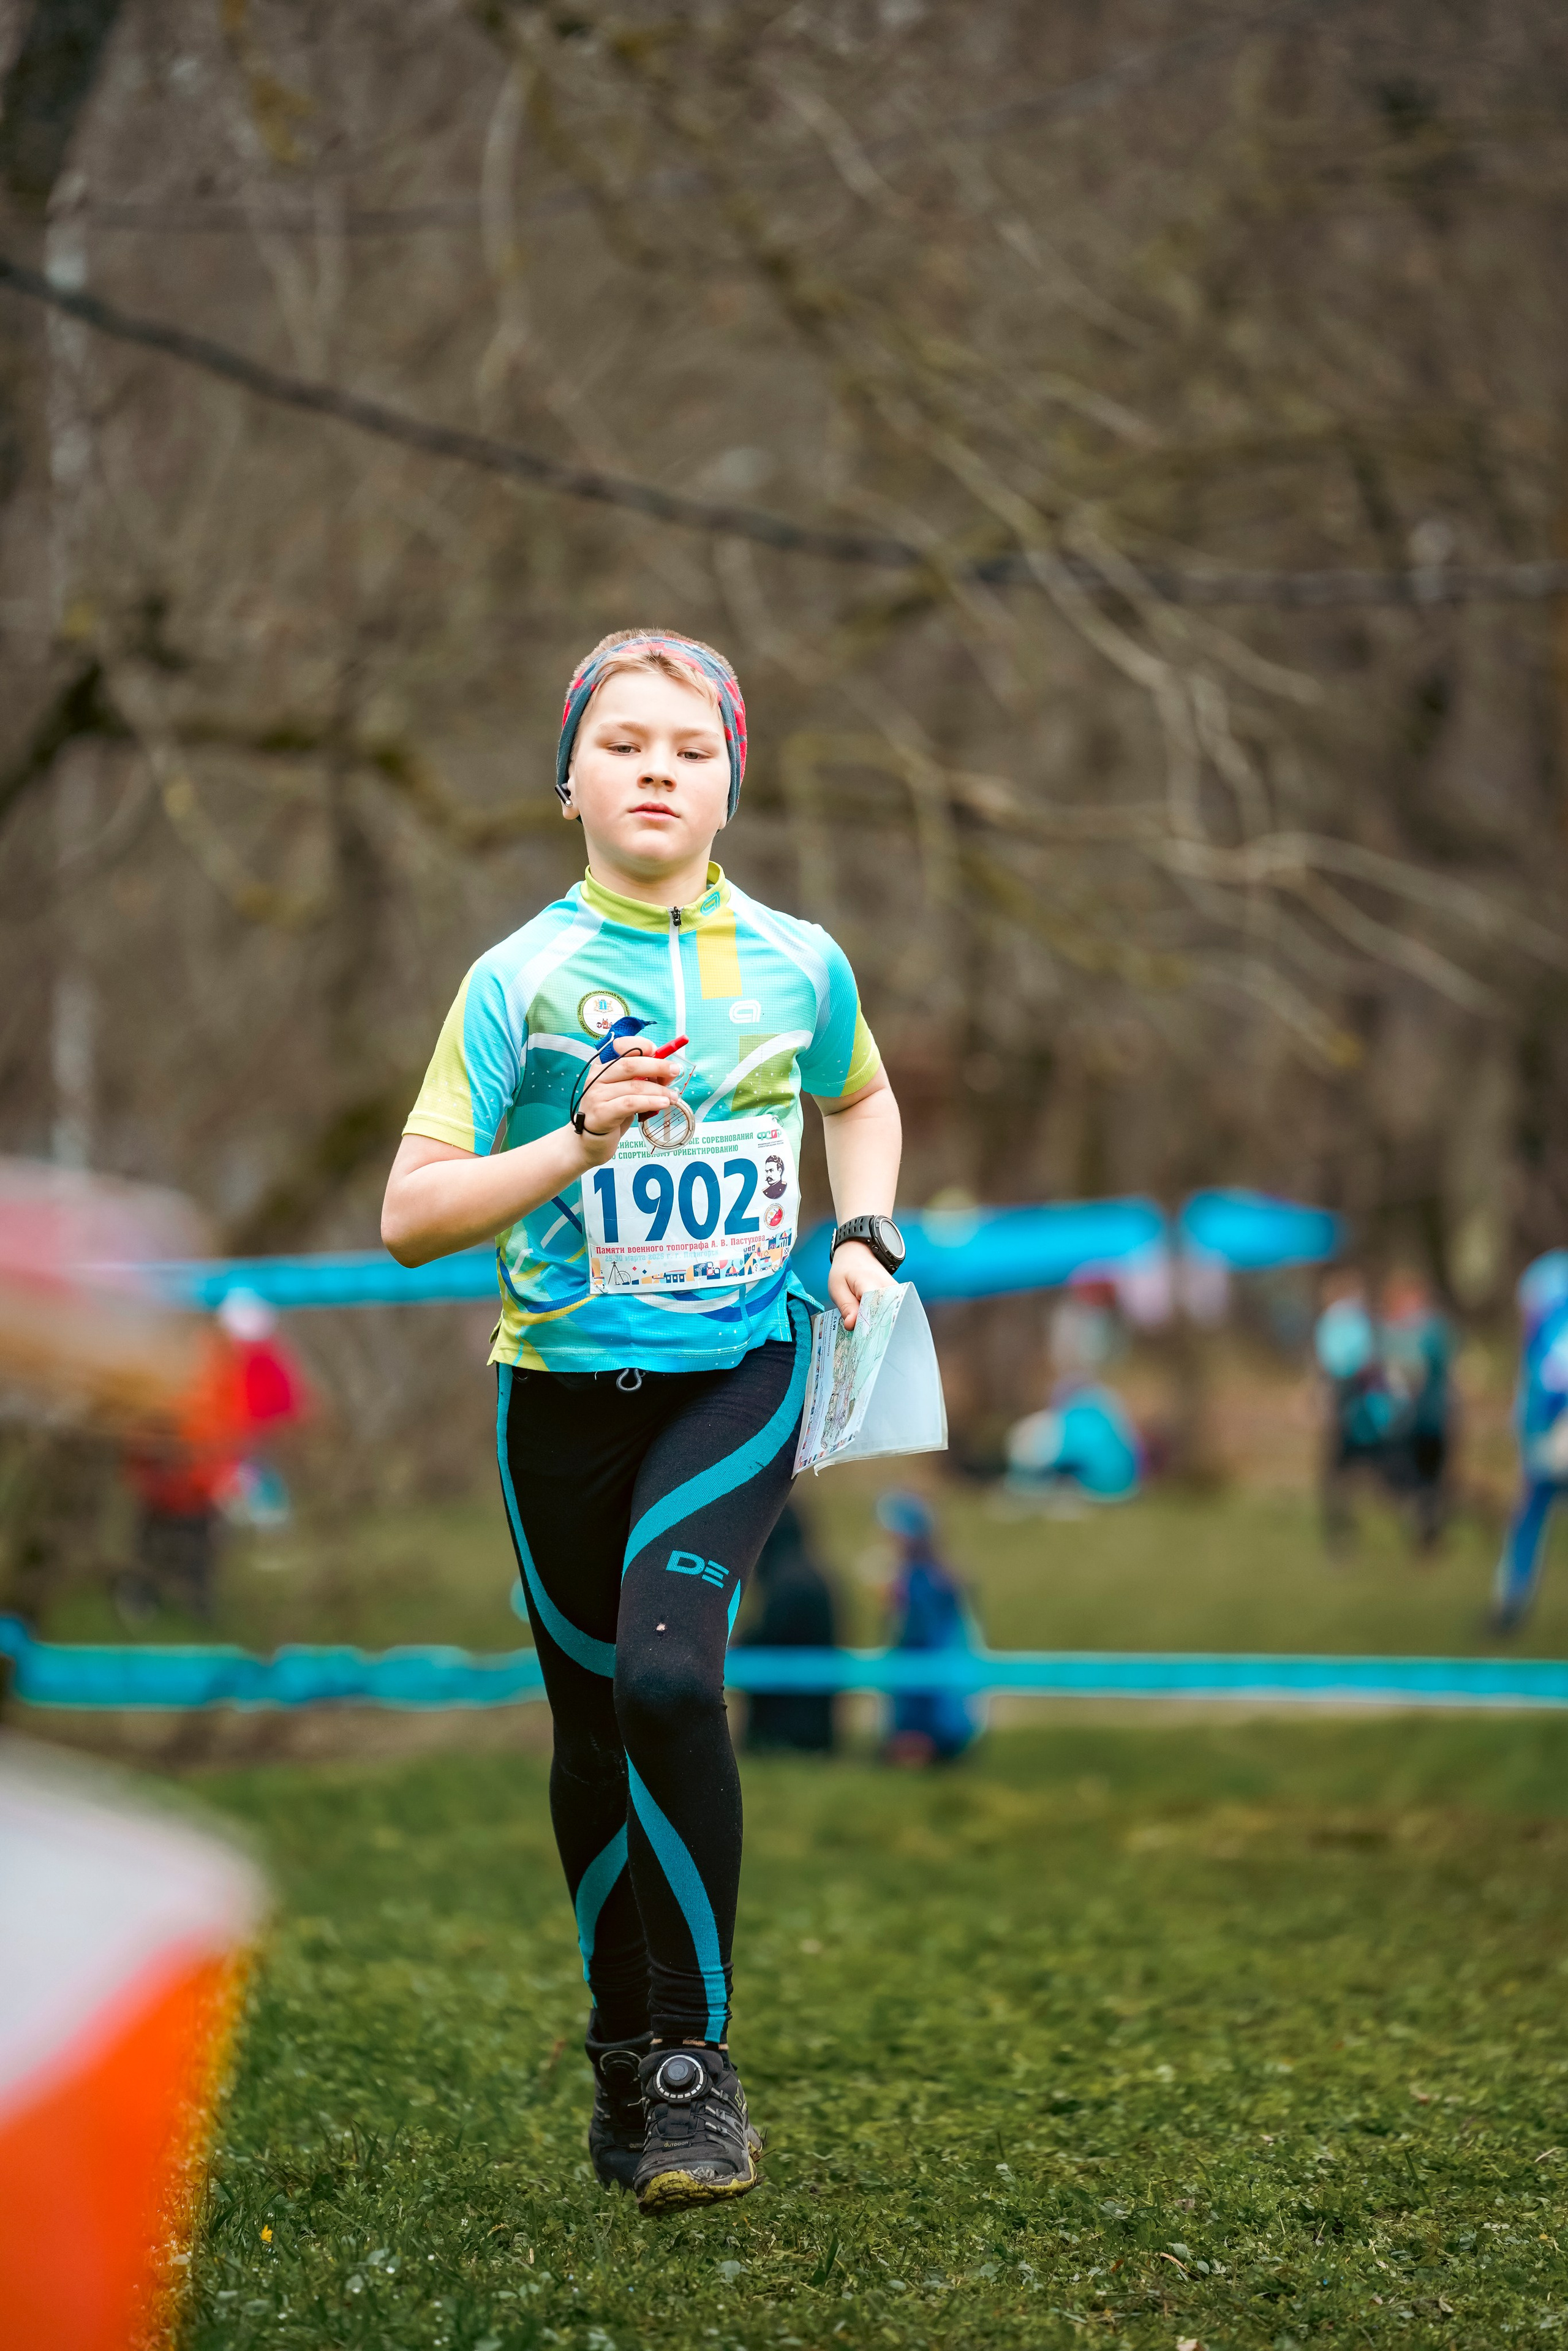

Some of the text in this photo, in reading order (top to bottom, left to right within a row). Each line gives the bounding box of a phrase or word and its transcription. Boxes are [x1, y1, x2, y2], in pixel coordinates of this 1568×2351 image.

[702, 1132, 753, 1144] СОРЕВНОВАНИЯ
[673, 1144, 739, 1157] ОРИЕНТИРОВАНИЮ
[594, 1158, 760, 1243] 1902
[627, 1245, 663, 1253] военного
[666, 1241, 709, 1251] топографа
[731, 1235, 766, 1245] Пастухова
